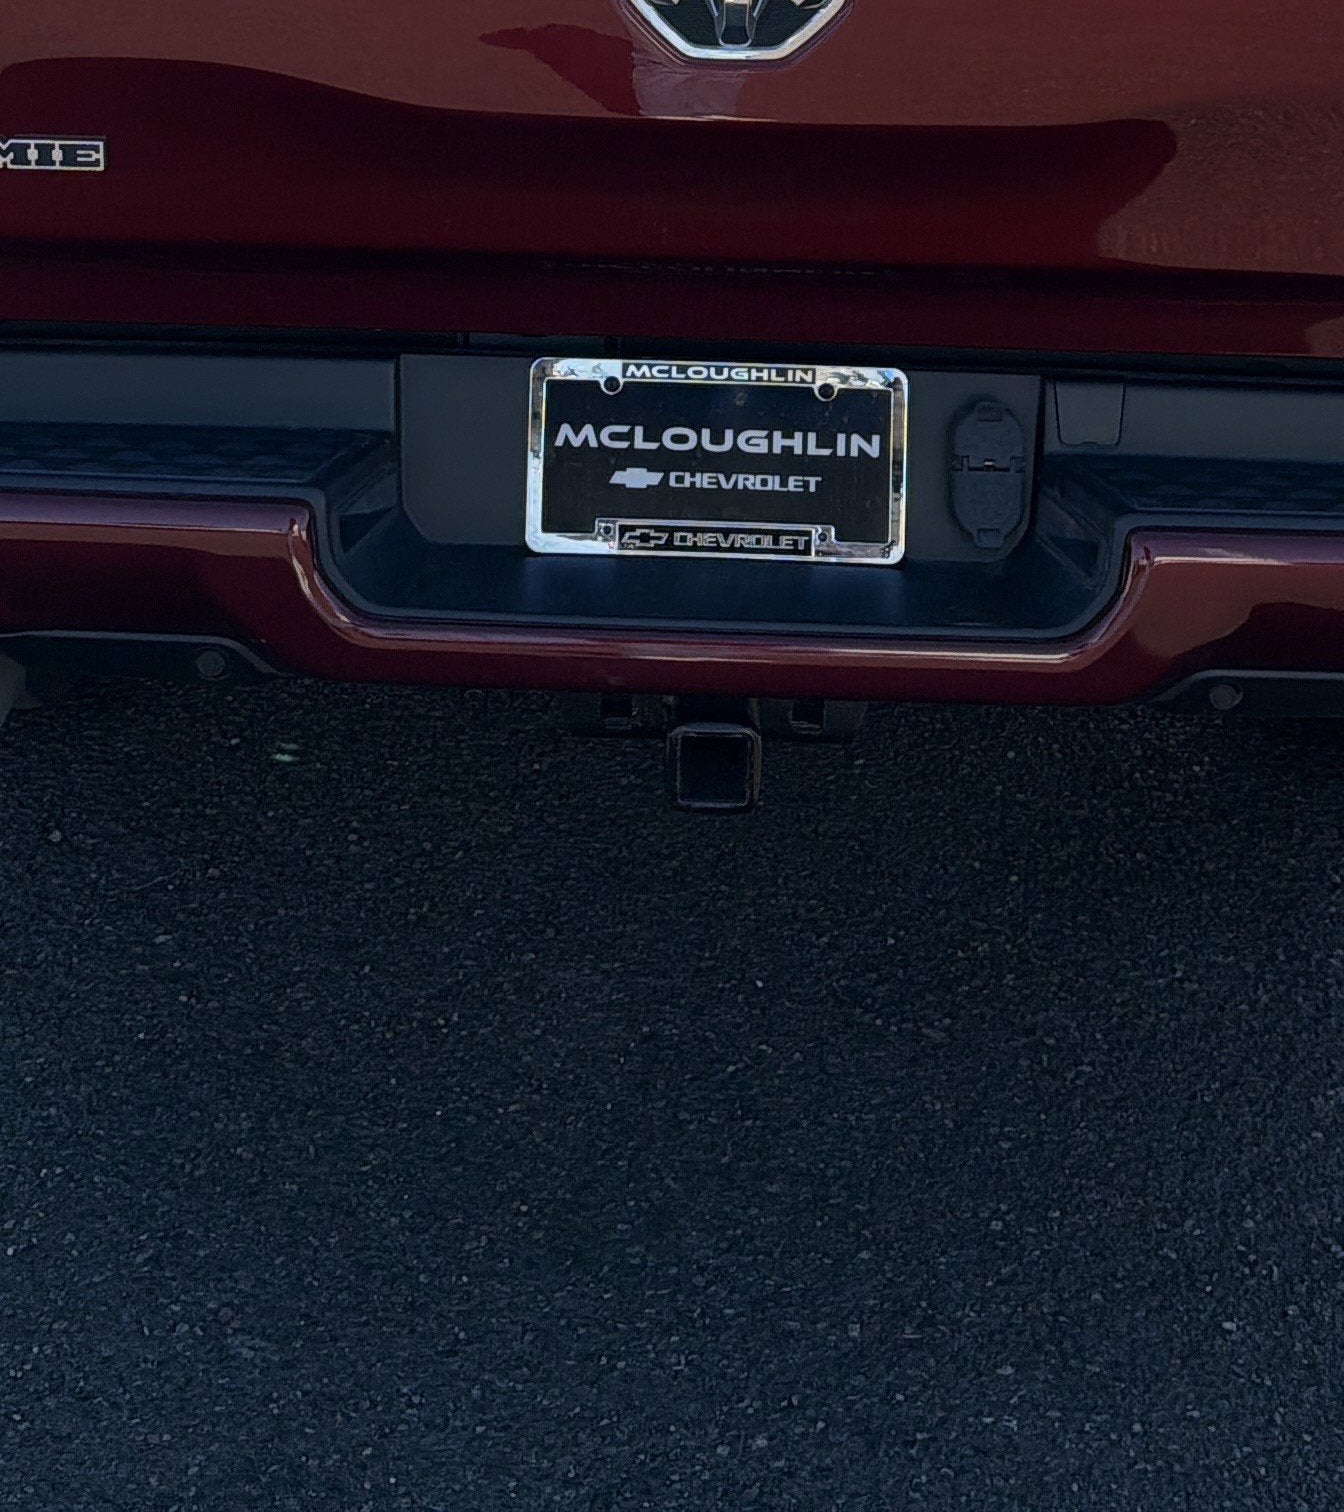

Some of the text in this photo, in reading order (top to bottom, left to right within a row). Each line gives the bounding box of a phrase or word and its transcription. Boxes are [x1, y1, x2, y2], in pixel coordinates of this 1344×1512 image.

[625, 364, 814, 384] MCLOUGHLIN
[554, 422, 882, 459] MCLOUGHLIN
[668, 470, 823, 494] CHEVROLET
[673, 530, 811, 551] CHEVROLET
